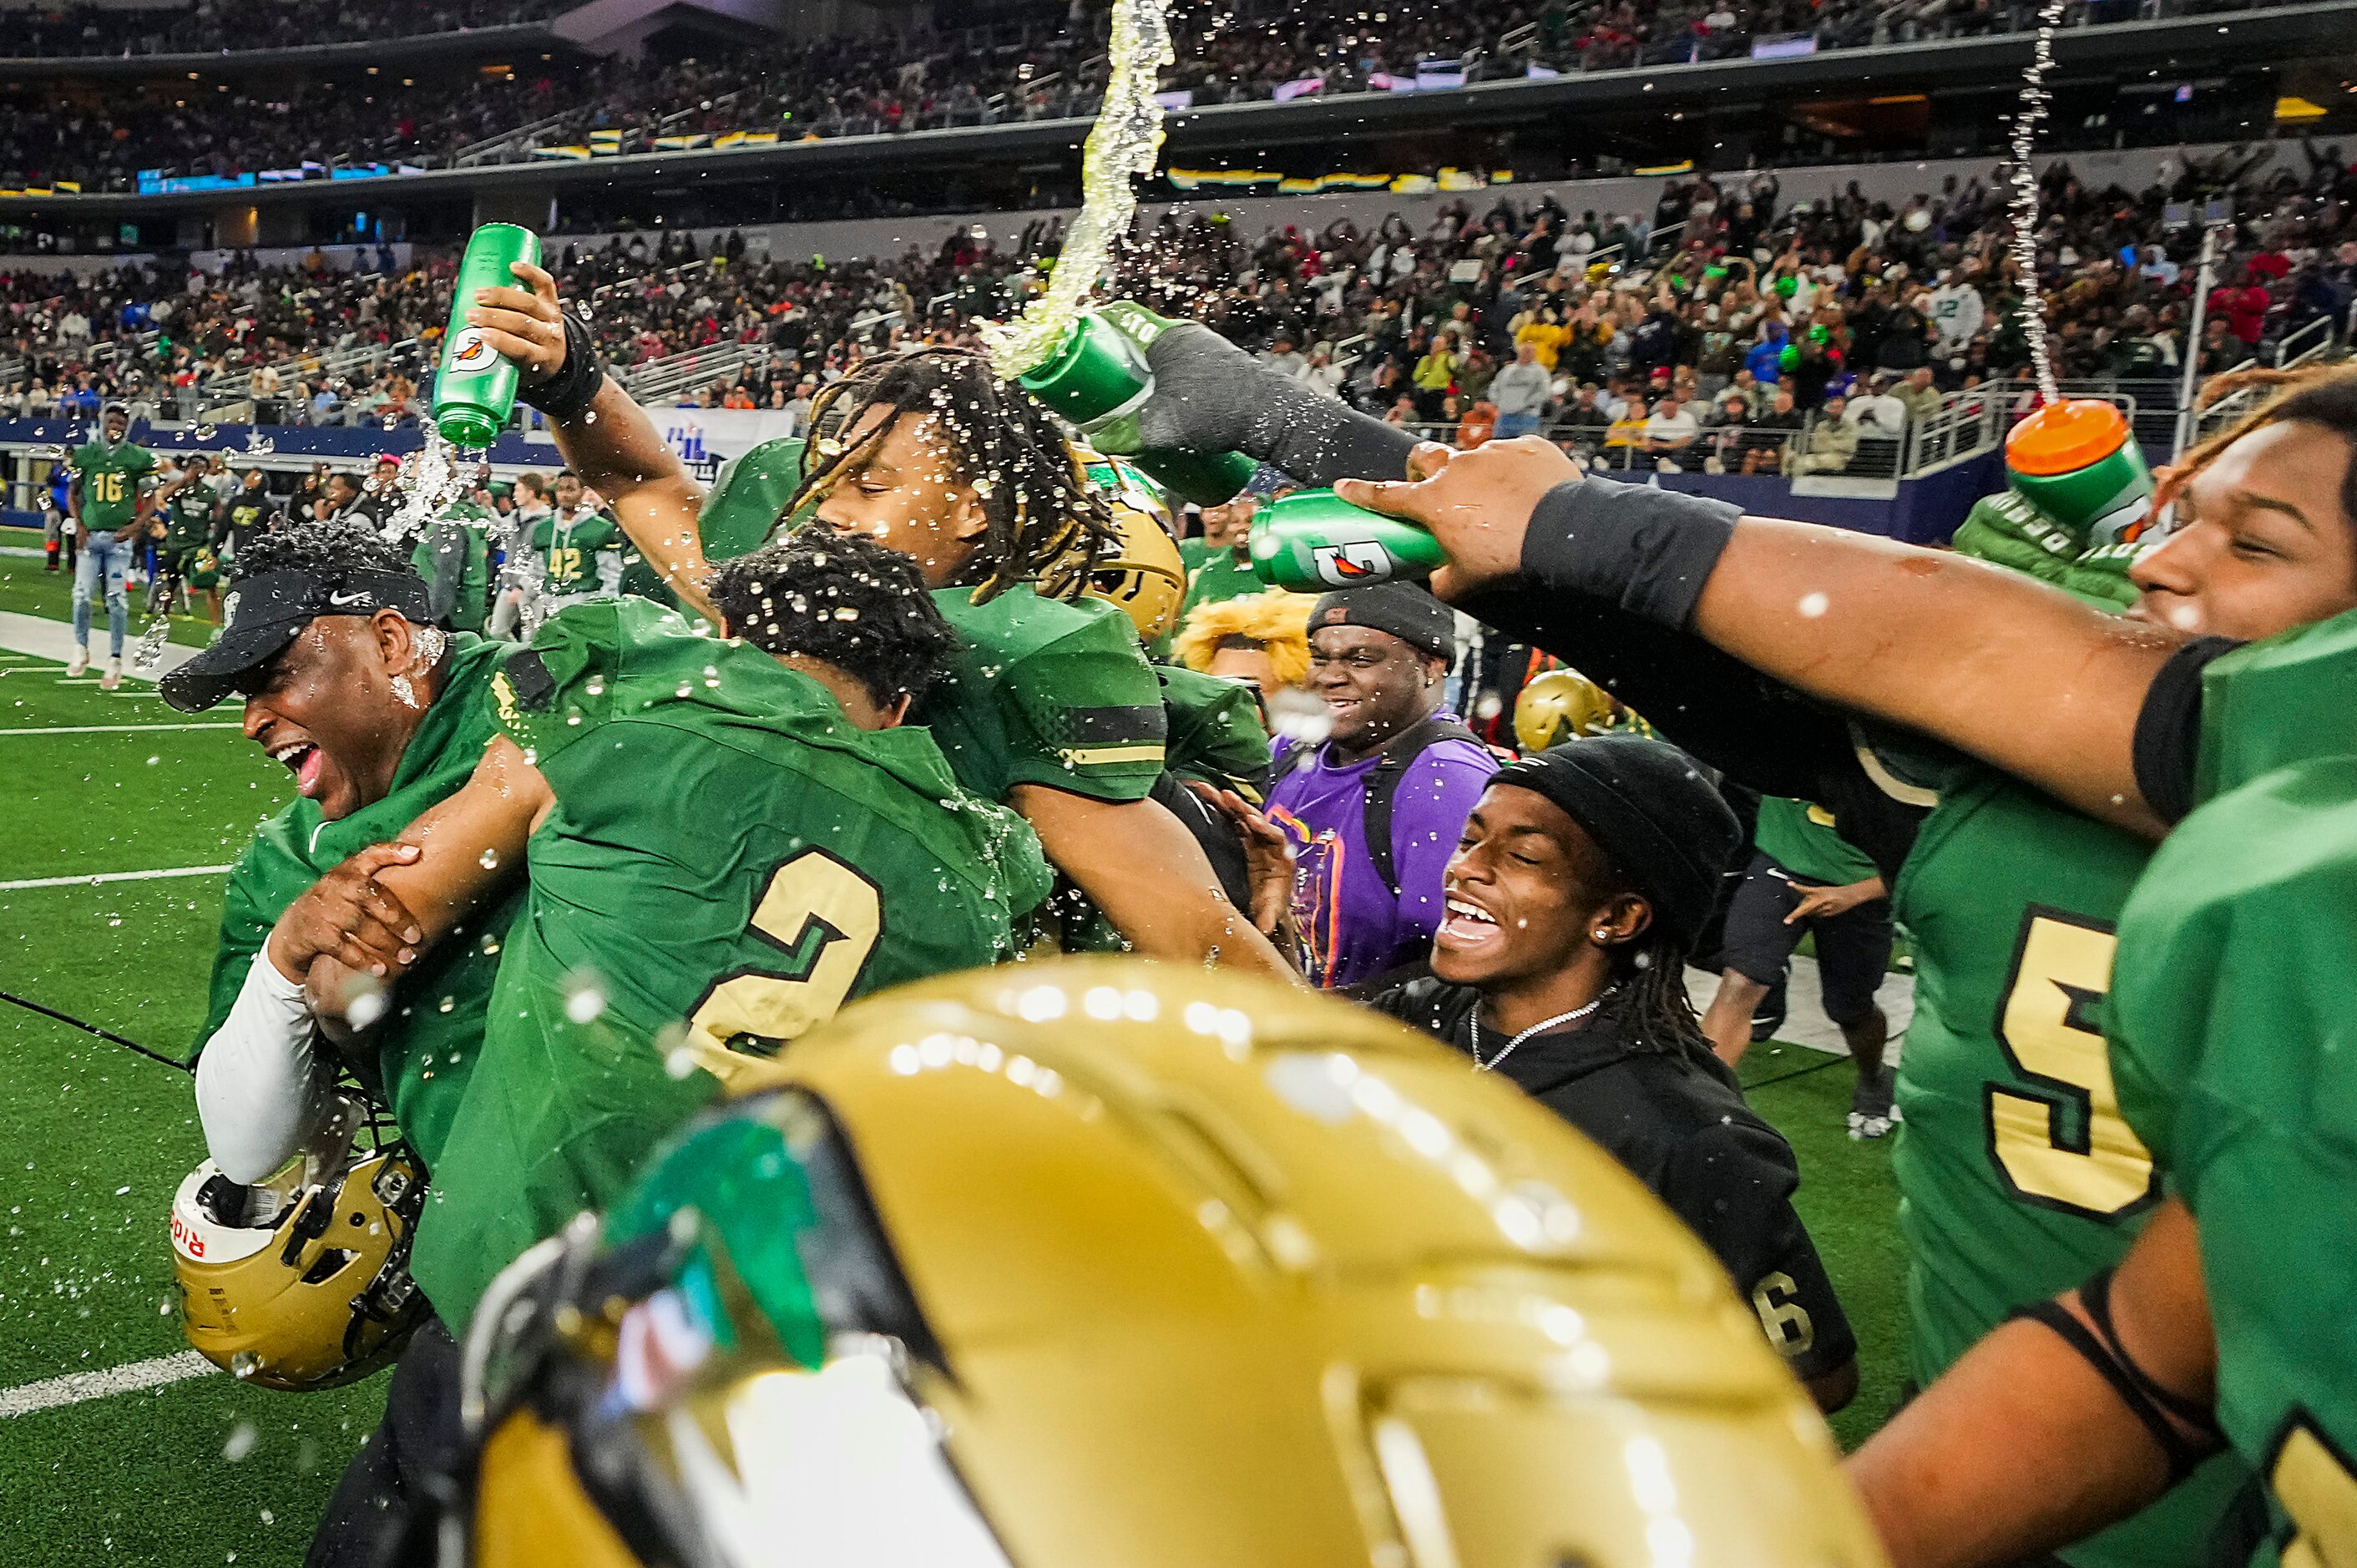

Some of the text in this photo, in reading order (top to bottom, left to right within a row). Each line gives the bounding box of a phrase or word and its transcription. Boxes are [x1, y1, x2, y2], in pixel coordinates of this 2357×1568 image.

[94, 473, 124, 502] 16
[549, 548, 583, 579] 42
[684, 844, 884, 1080] 2
[1984, 902, 2164, 1222] 5
[1753, 1271, 1814, 1356] 6
